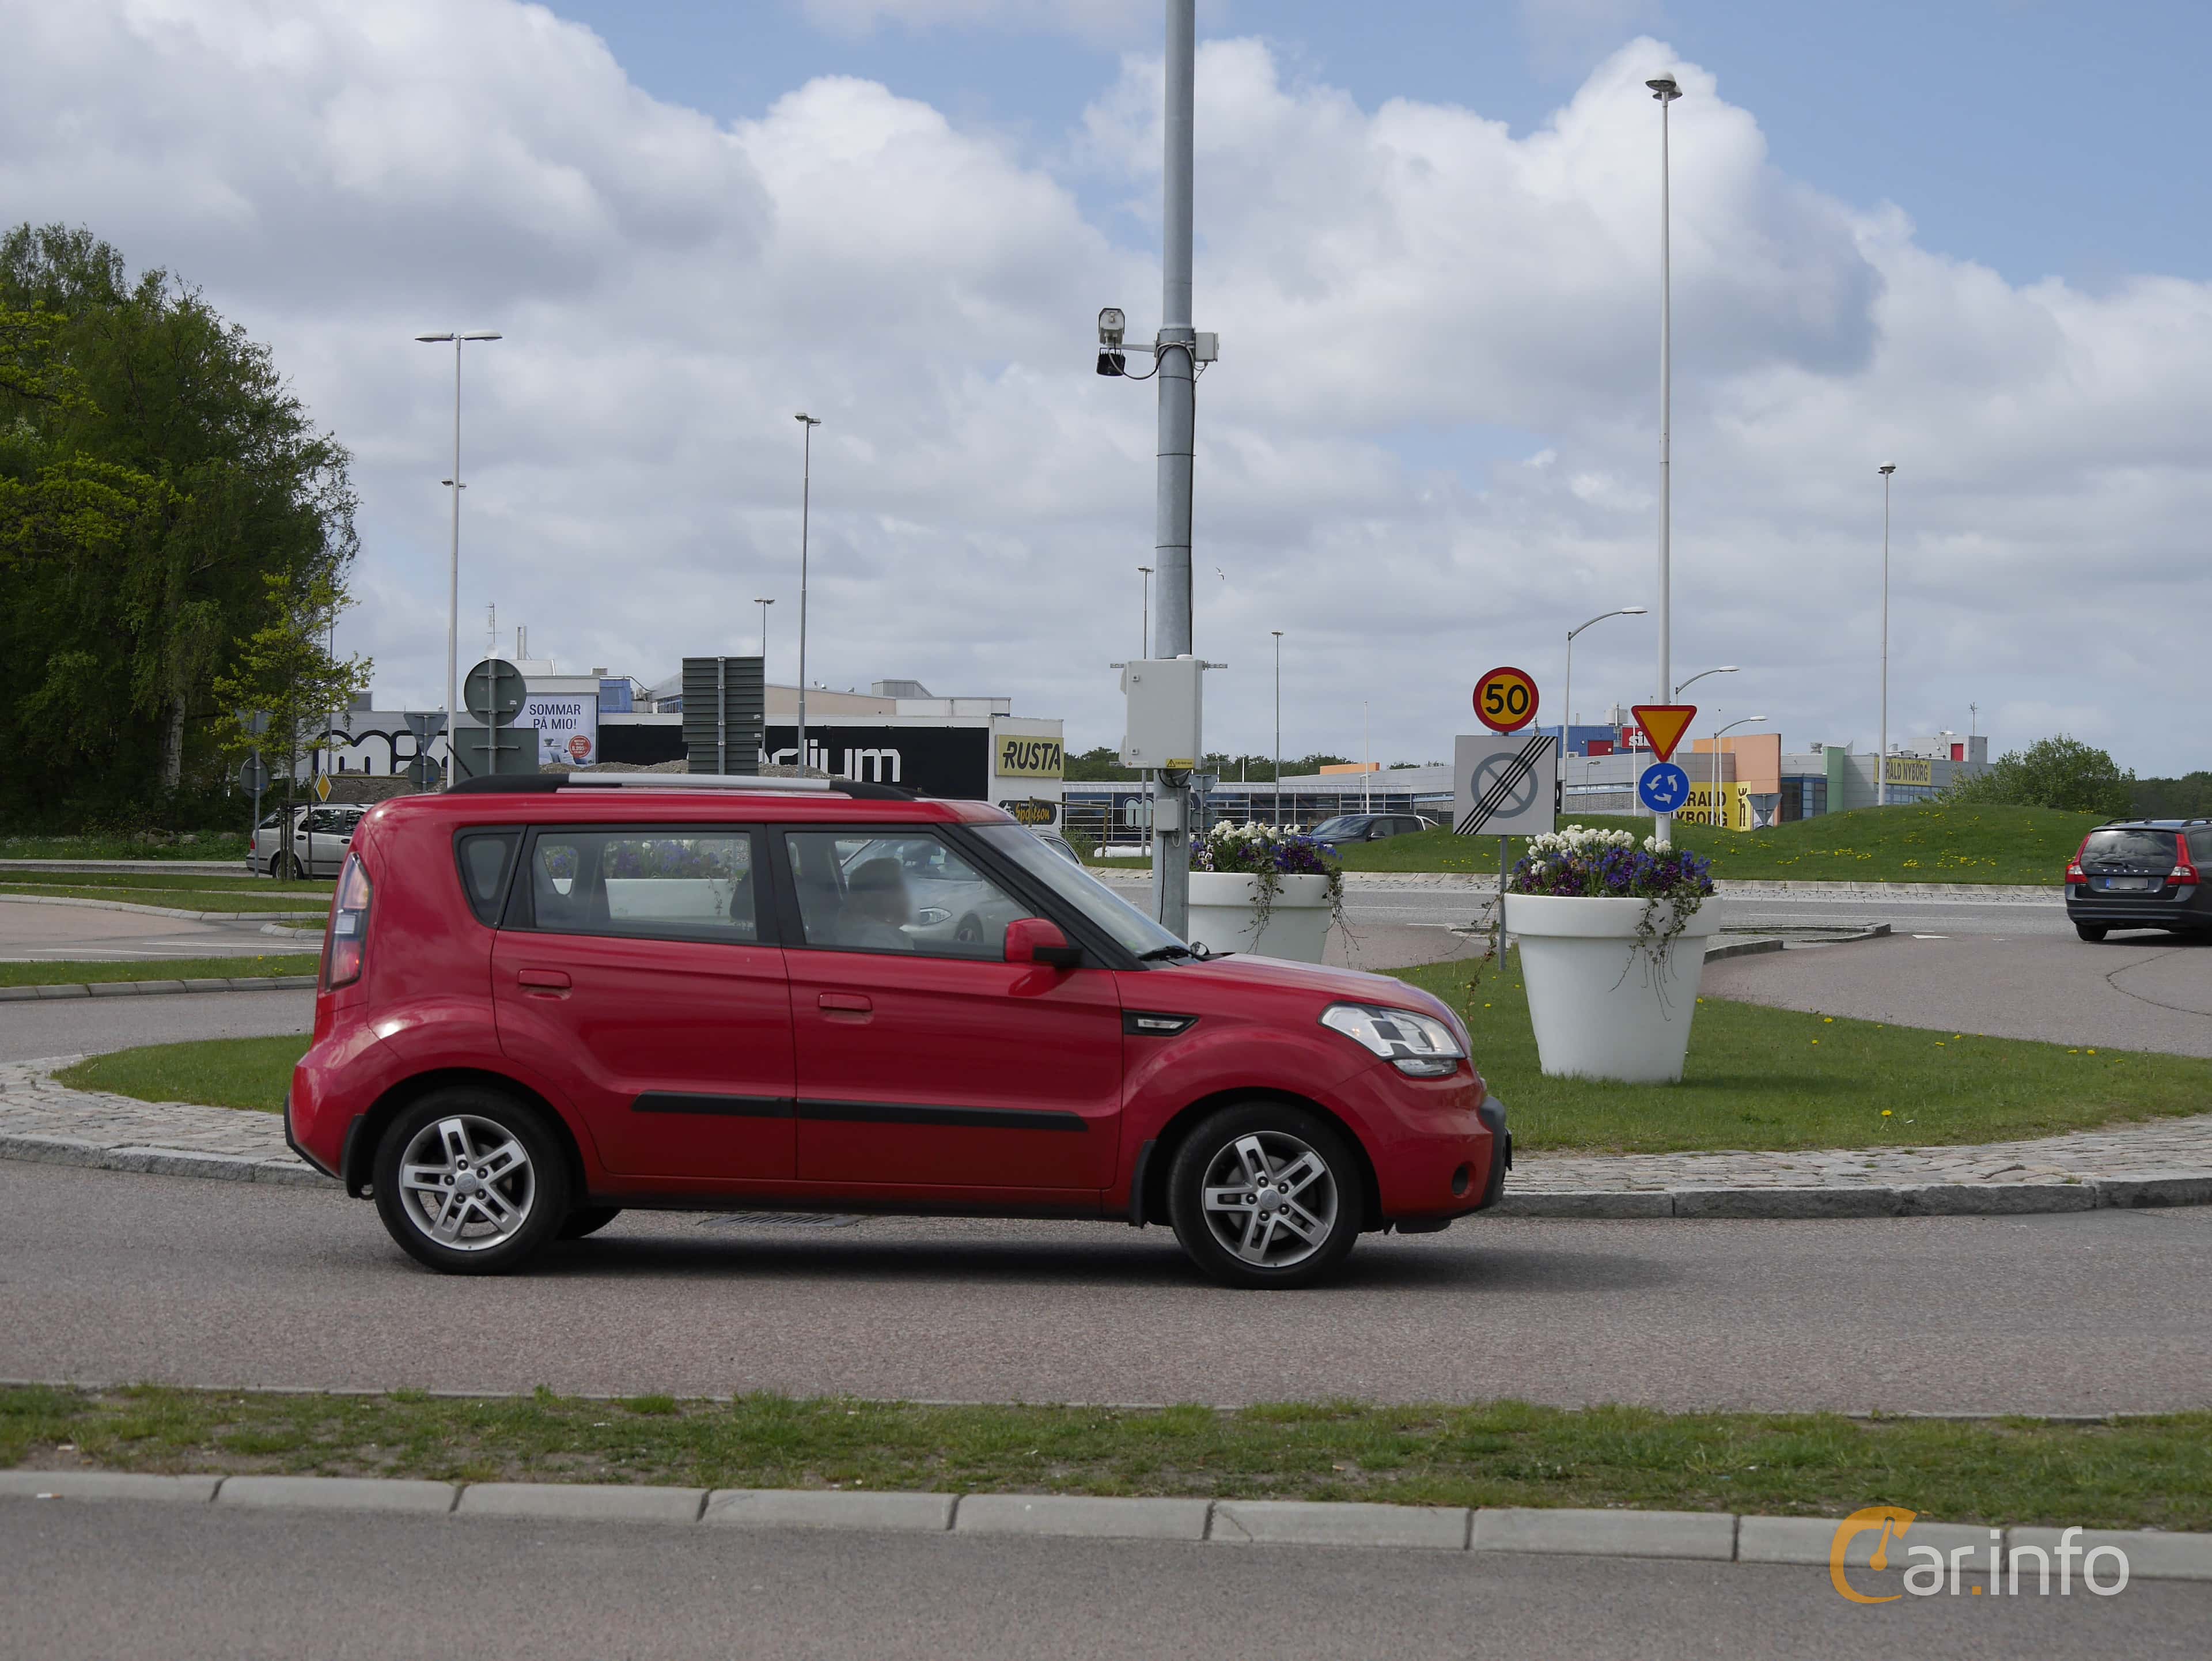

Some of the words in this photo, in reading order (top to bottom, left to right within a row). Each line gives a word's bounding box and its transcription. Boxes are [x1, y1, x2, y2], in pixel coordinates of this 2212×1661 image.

[1485, 684, 1529, 715] 50
[529, 703, 581, 716] SOMMAR
[533, 716, 548, 730] PÅ
[551, 718, 577, 730] MIO!
[1002, 741, 1060, 771] RUSTA
[1877, 761, 1902, 780] RALD
[1903, 763, 1928, 782] NYBORG
[1683, 791, 1727, 807] RALD
[1015, 801, 1051, 825] Spotson
[1671, 811, 1728, 827] YBORG
